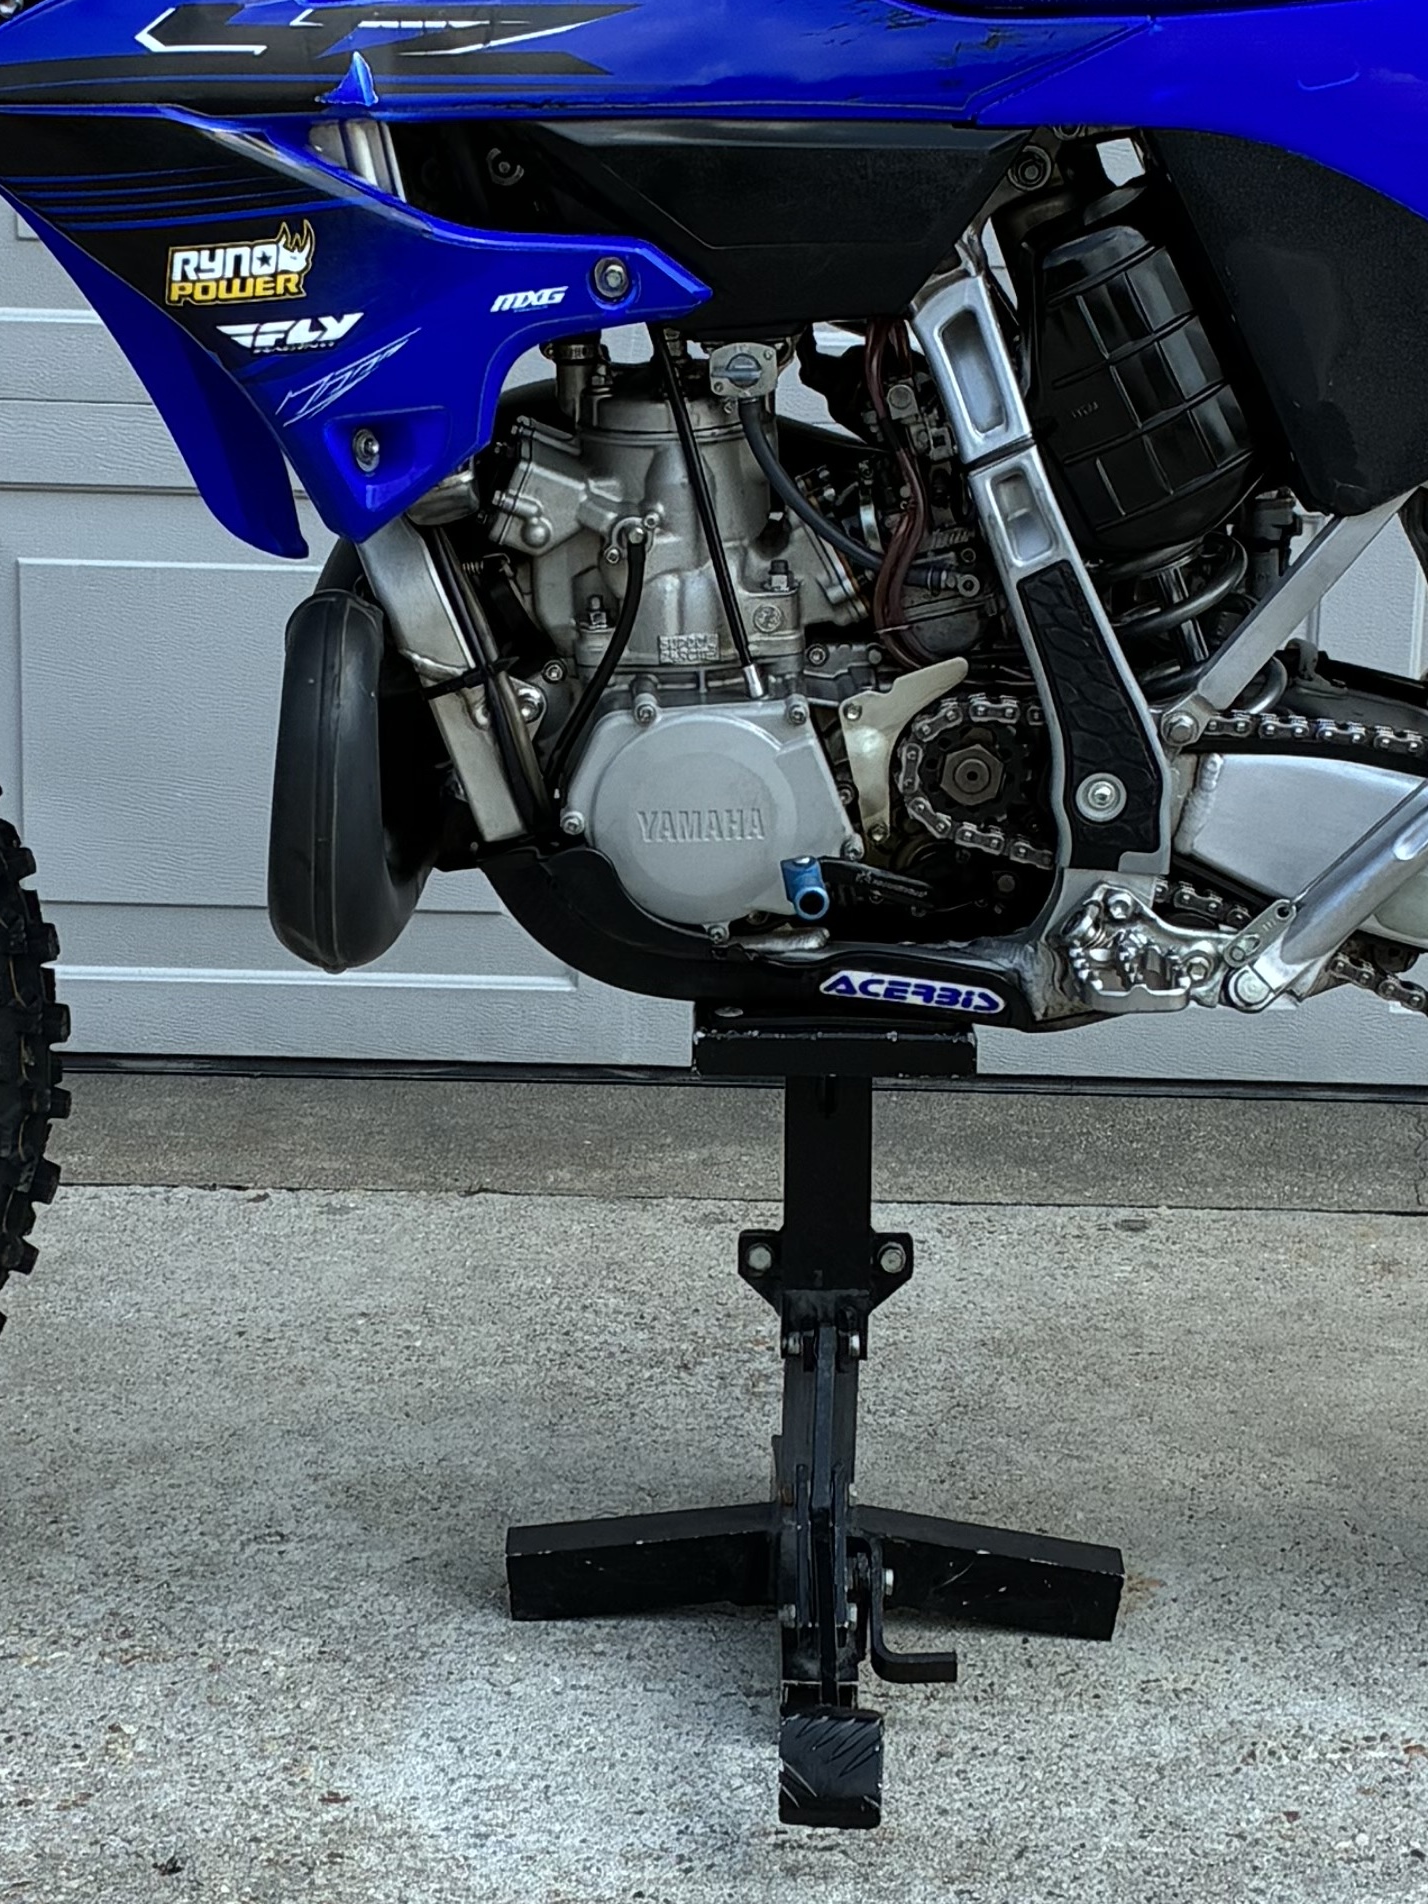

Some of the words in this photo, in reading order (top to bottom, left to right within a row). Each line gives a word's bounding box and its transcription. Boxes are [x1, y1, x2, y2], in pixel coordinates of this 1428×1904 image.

[170, 273, 300, 302] POWER
[220, 312, 364, 348] FLY
[636, 807, 765, 843] YAMAHA
[823, 975, 1000, 1012] ACERBIS
